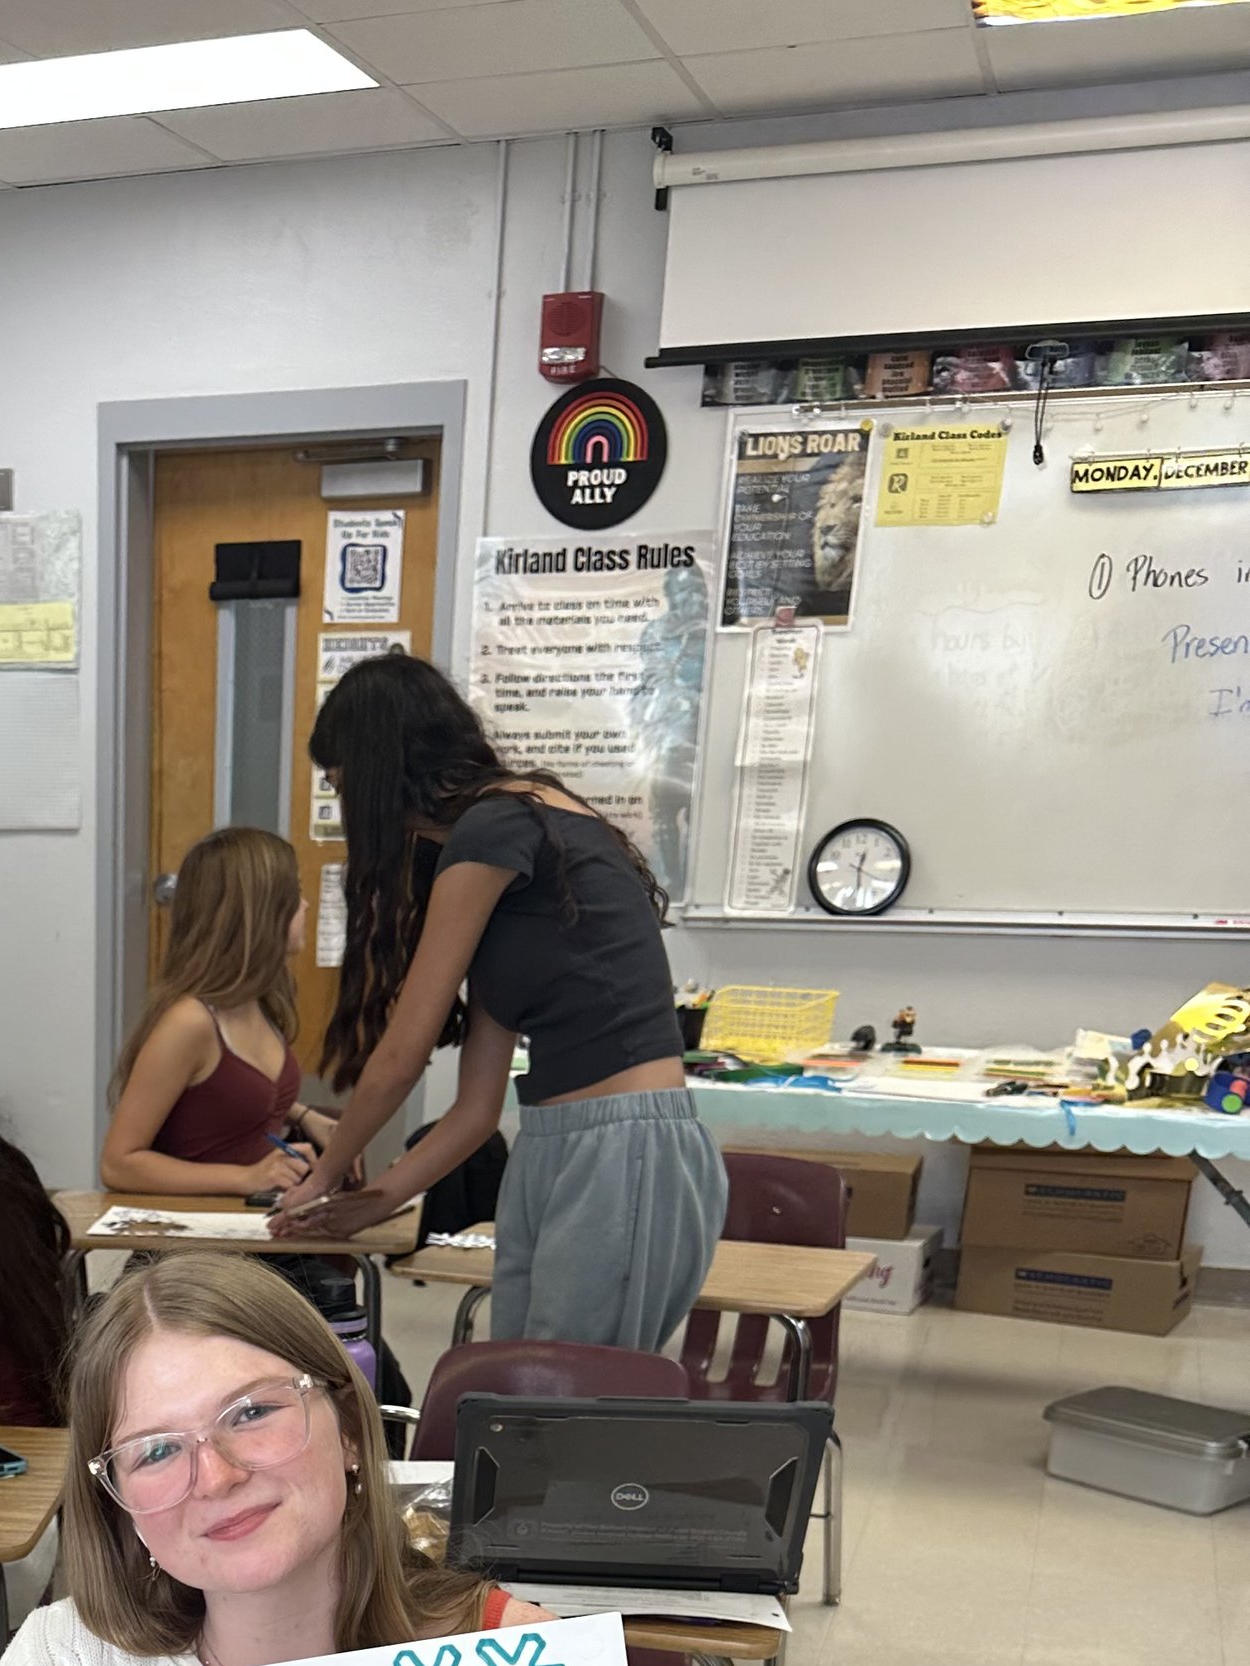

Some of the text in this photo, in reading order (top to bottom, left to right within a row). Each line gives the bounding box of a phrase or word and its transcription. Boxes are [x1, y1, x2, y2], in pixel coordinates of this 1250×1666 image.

[746, 433, 861, 456] LIONS ROAR
[893, 430, 1002, 441] Kirland Class Codes
[567, 468, 628, 487] PROUD
[1165, 460, 1248, 479] DECEMBER
[571, 486, 618, 505] ALLY
[495, 543, 695, 575] Kirland Class Rules
[1126, 554, 1209, 592] Phones
